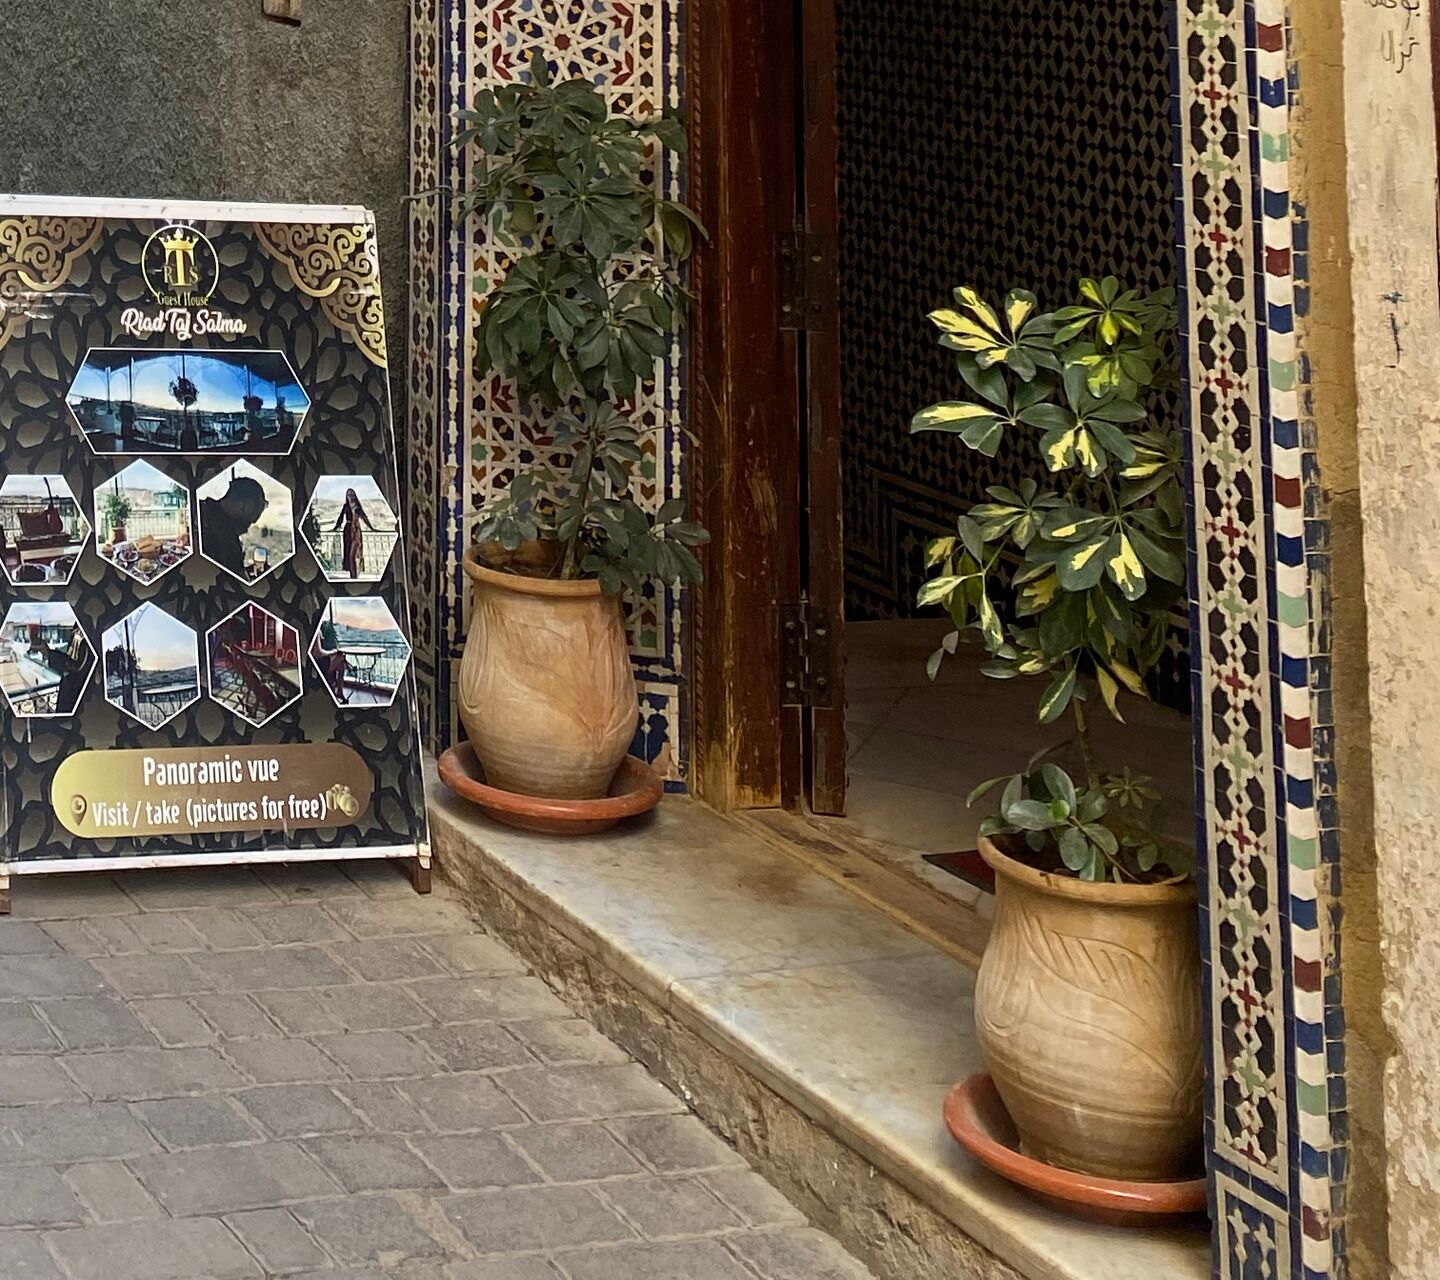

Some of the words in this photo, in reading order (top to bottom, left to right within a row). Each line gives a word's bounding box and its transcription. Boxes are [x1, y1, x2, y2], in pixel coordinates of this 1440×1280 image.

[157, 291, 181, 307] Guest
[183, 291, 210, 307] House
[120, 307, 166, 336] Riad
[165, 307, 192, 340] Taj
[192, 308, 248, 336] Salma
[143, 754, 244, 786] Panoramic
[246, 758, 281, 783] vue
[91, 800, 130, 828] Visit
[145, 801, 181, 826] take
[185, 795, 259, 829] (pictures
[260, 795, 285, 820] for
[287, 793, 328, 822] free)
